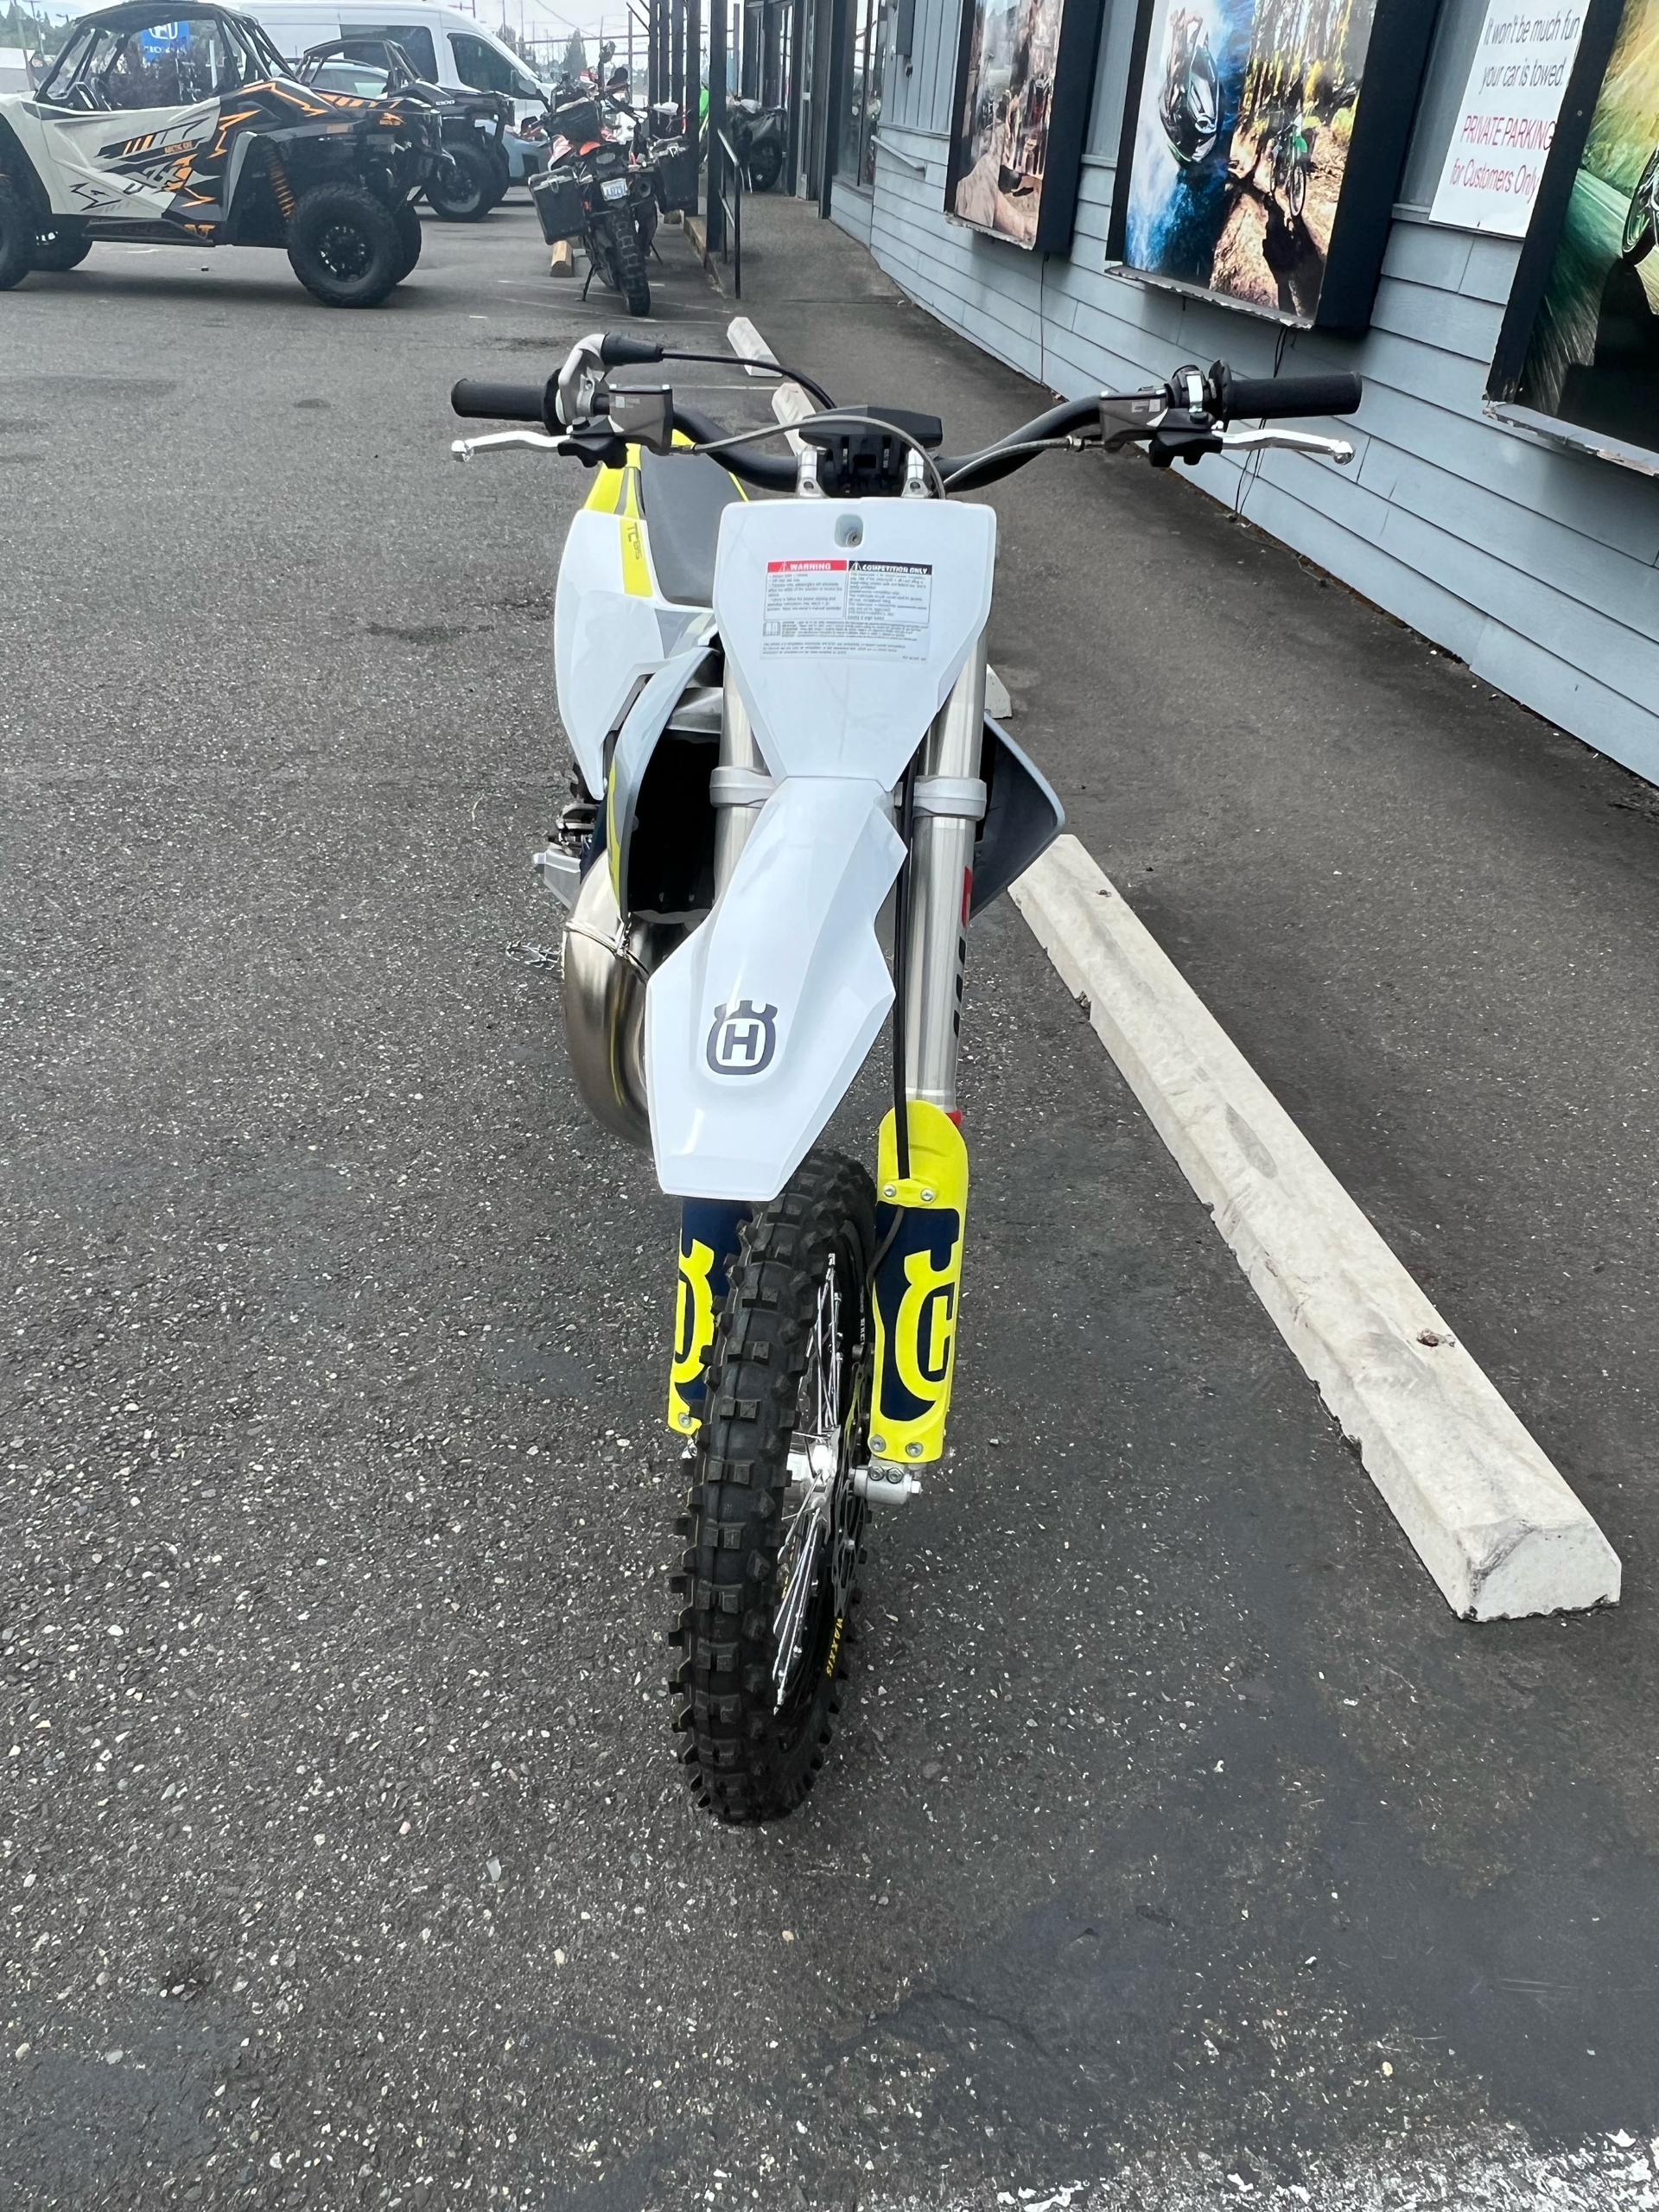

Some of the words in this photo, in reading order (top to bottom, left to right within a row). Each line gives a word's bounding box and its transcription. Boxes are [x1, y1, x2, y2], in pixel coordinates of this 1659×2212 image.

[1491, 15, 1519, 44] won't
[1516, 15, 1531, 43] be
[1529, 11, 1561, 42] much
[1560, 9, 1580, 41] fun
[1478, 65, 1504, 95] your
[1503, 65, 1521, 86] car
[1519, 57, 1530, 86] is
[1529, 56, 1567, 86] towed.
[1460, 115, 1504, 146] PRIVATE
[1500, 118, 1556, 150] PARKING
[1450, 158, 1465, 185] for
[1463, 158, 1514, 193] Customers
[1514, 164, 1541, 204] Only
[790, 563, 831, 571] WARNING
[862, 563, 908, 574] COMPETITION
[825, 1618, 843, 1678] MAXXIS
